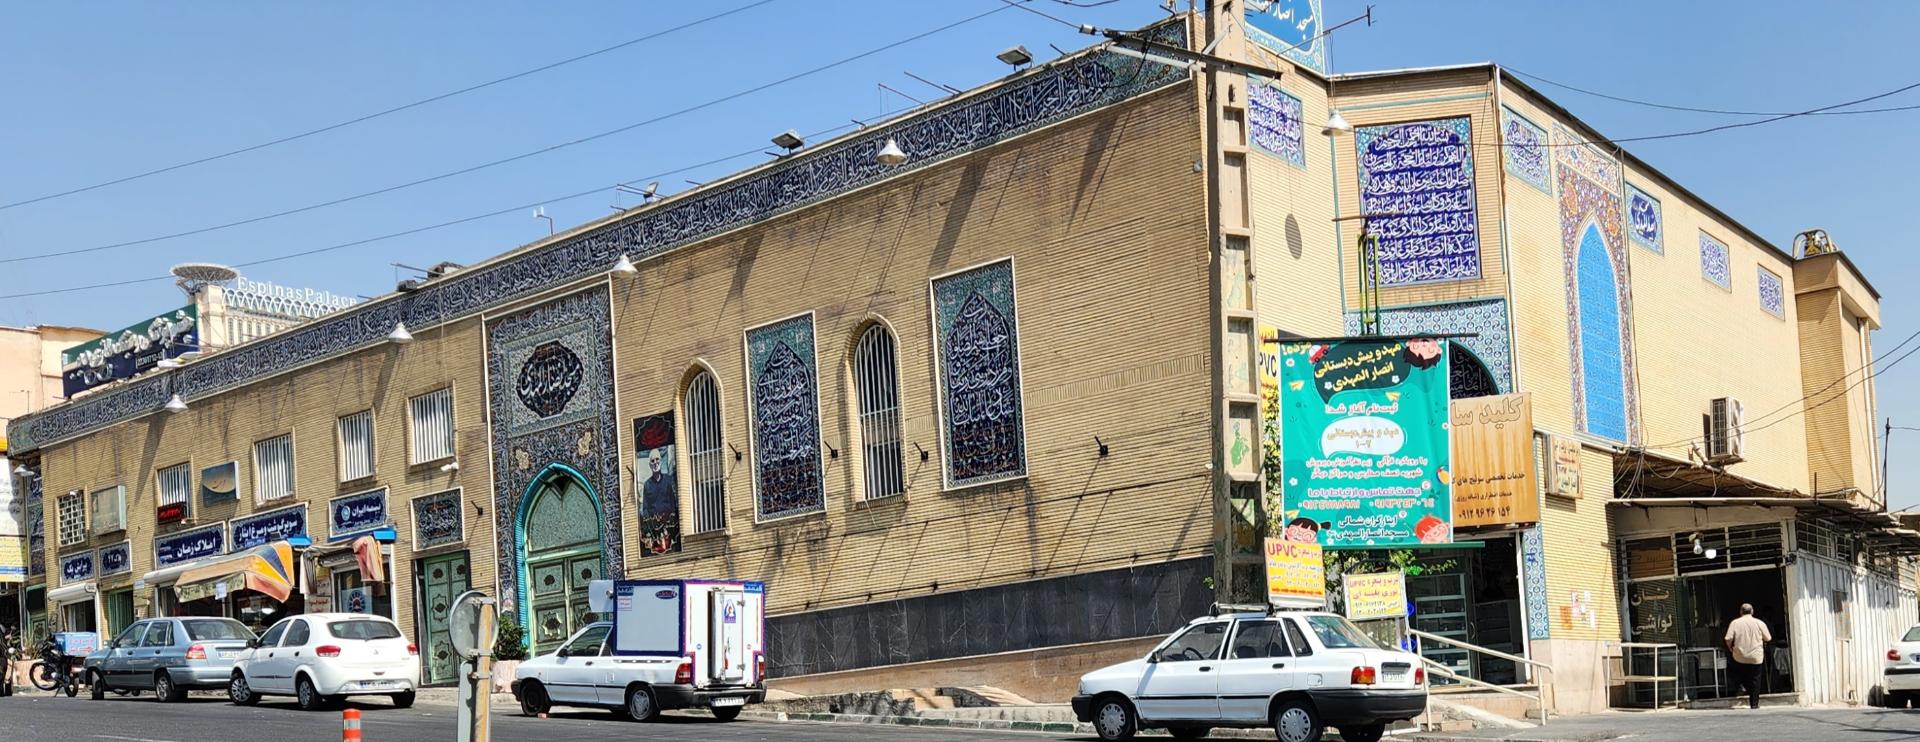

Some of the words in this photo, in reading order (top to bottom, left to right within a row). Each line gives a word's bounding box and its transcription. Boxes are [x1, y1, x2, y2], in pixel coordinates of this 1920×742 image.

[1296, 14, 1314, 41] مسجد
[1354, 351, 1376, 366] پیش
[1375, 349, 1382, 360] و
[1382, 343, 1401, 356] مهد
[1314, 357, 1353, 378] دبستانی
[1371, 361, 1394, 381] انصار
[1332, 368, 1369, 391] المهدی
[1479, 396, 1524, 429] کلید
[1268, 543, 1297, 558] UPVC
[1631, 588, 1669, 606] نان
